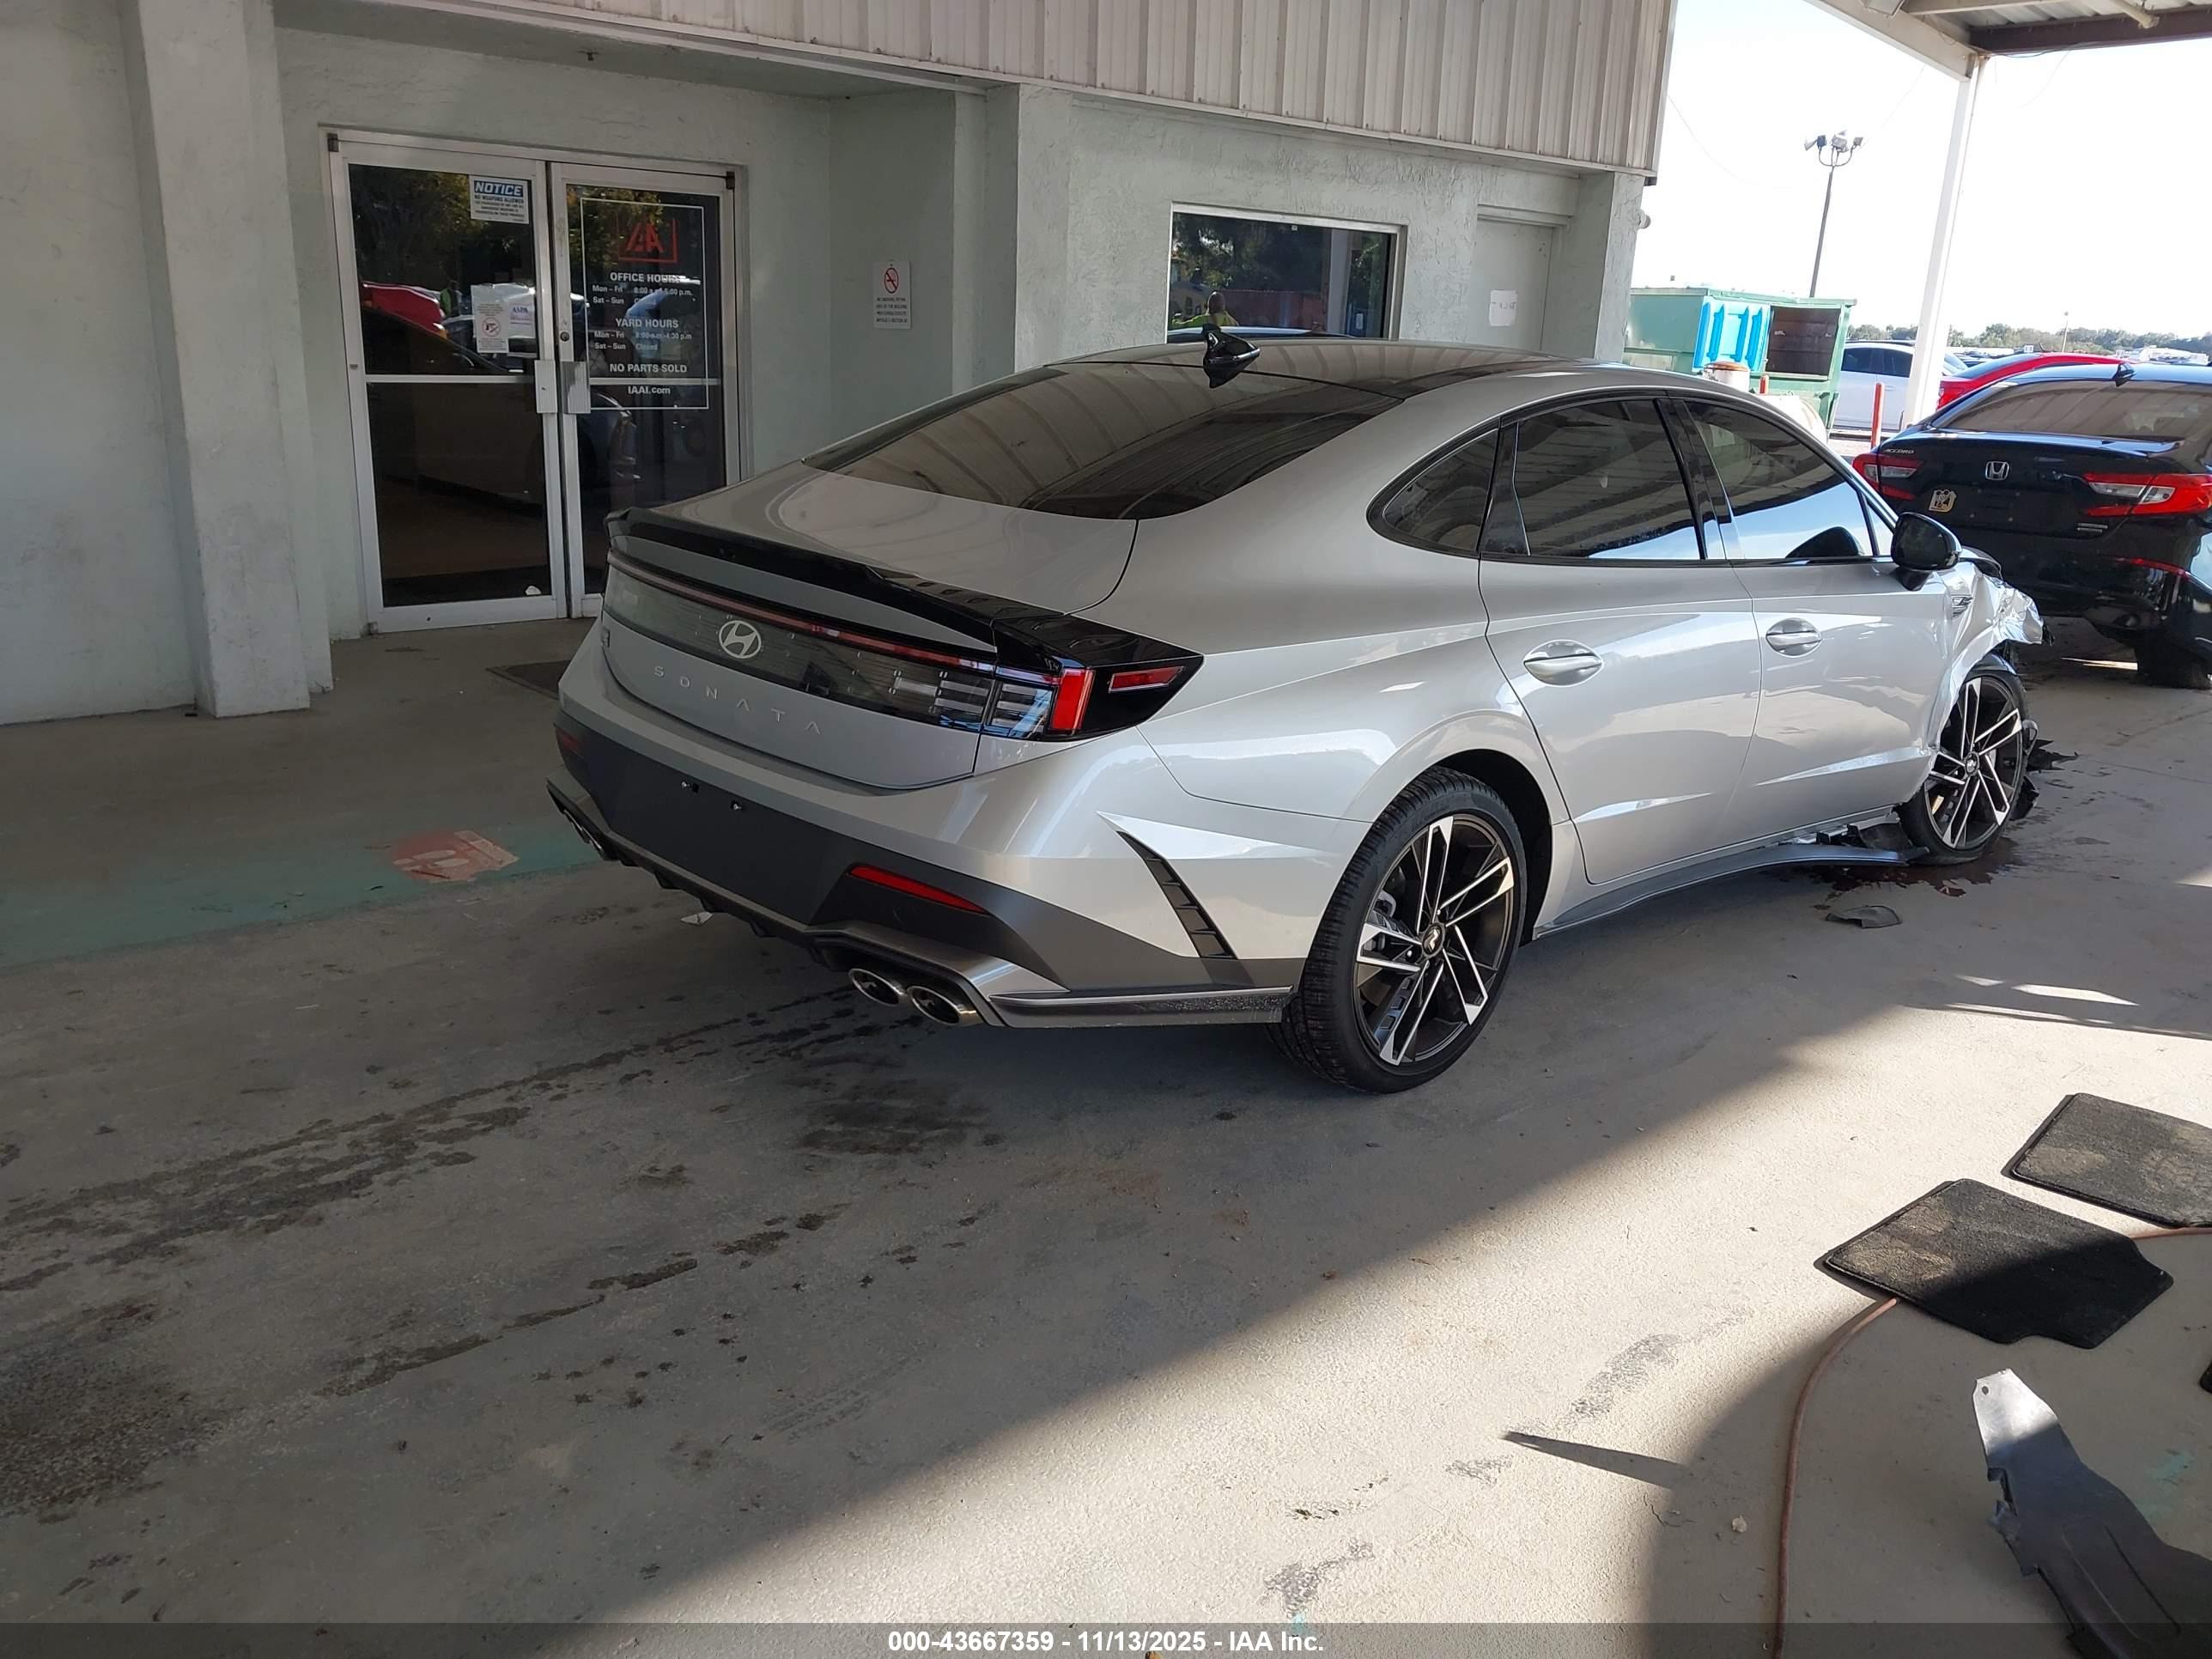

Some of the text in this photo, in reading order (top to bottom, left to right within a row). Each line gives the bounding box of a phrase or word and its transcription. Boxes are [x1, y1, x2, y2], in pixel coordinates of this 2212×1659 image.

[475, 181, 522, 196] NOTICE
[610, 271, 644, 283] OFFICE
[616, 318, 679, 329] YARD HOURS
[609, 363, 688, 373] NO PARTS SOLD
[628, 385, 671, 394] IAAI.com
[653, 665, 823, 736] SONATA
